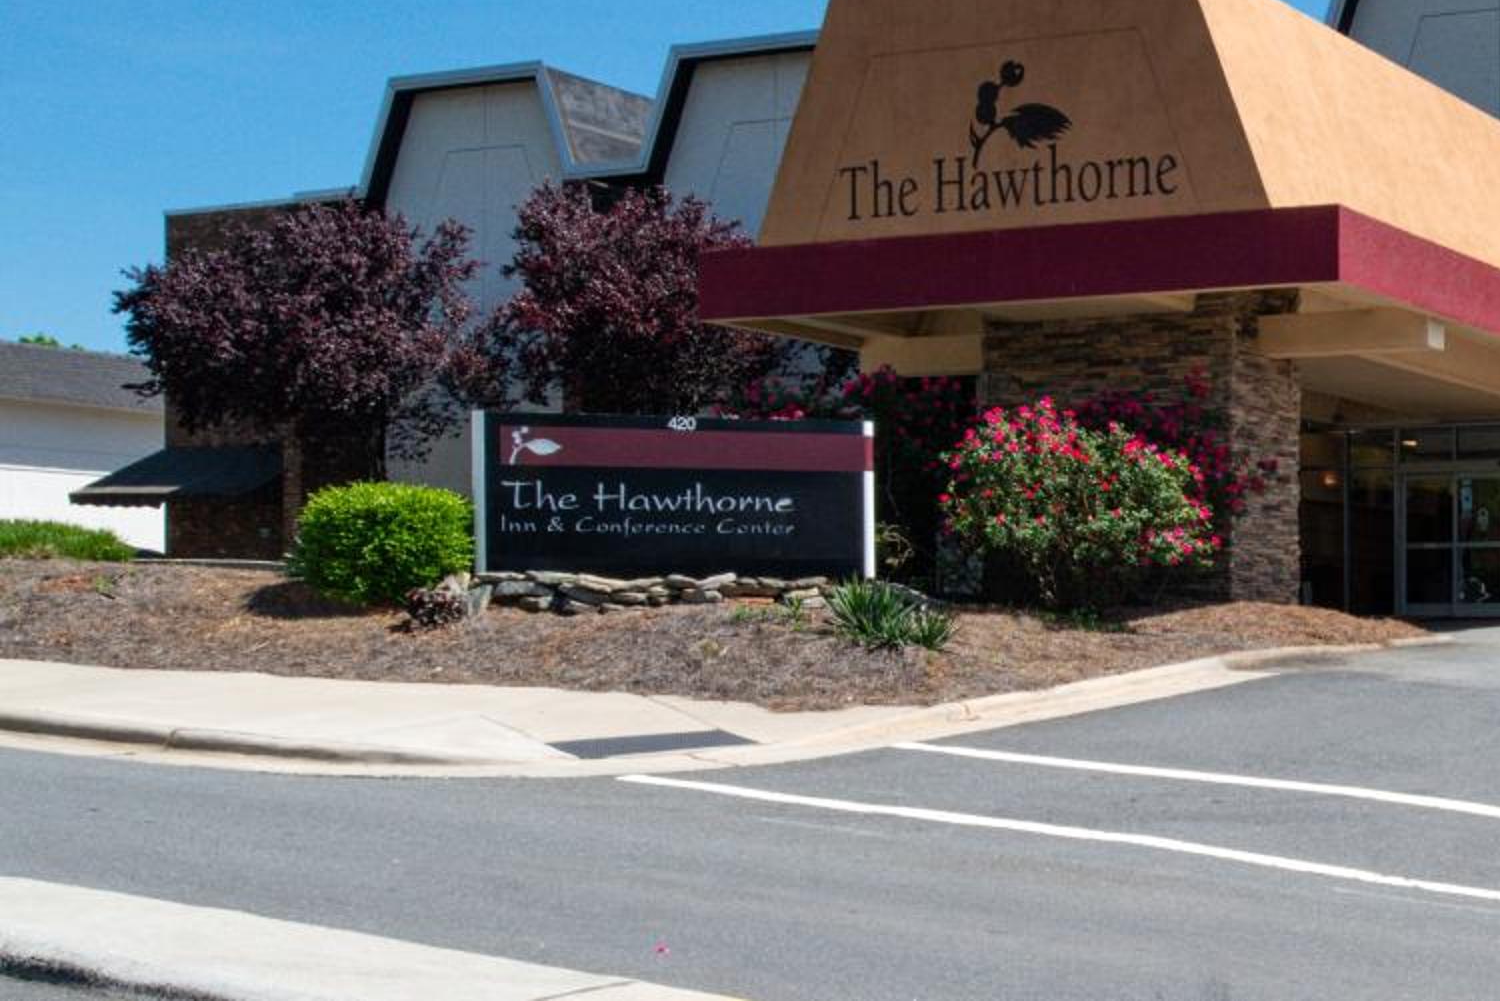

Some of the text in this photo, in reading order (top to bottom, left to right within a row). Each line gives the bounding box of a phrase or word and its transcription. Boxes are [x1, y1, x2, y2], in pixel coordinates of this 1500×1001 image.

[839, 144, 1178, 221] The Hawthorne
[667, 416, 697, 431] 420
[501, 480, 797, 514] The Hawthorne
[501, 514, 796, 538] Inn & Conference Center
